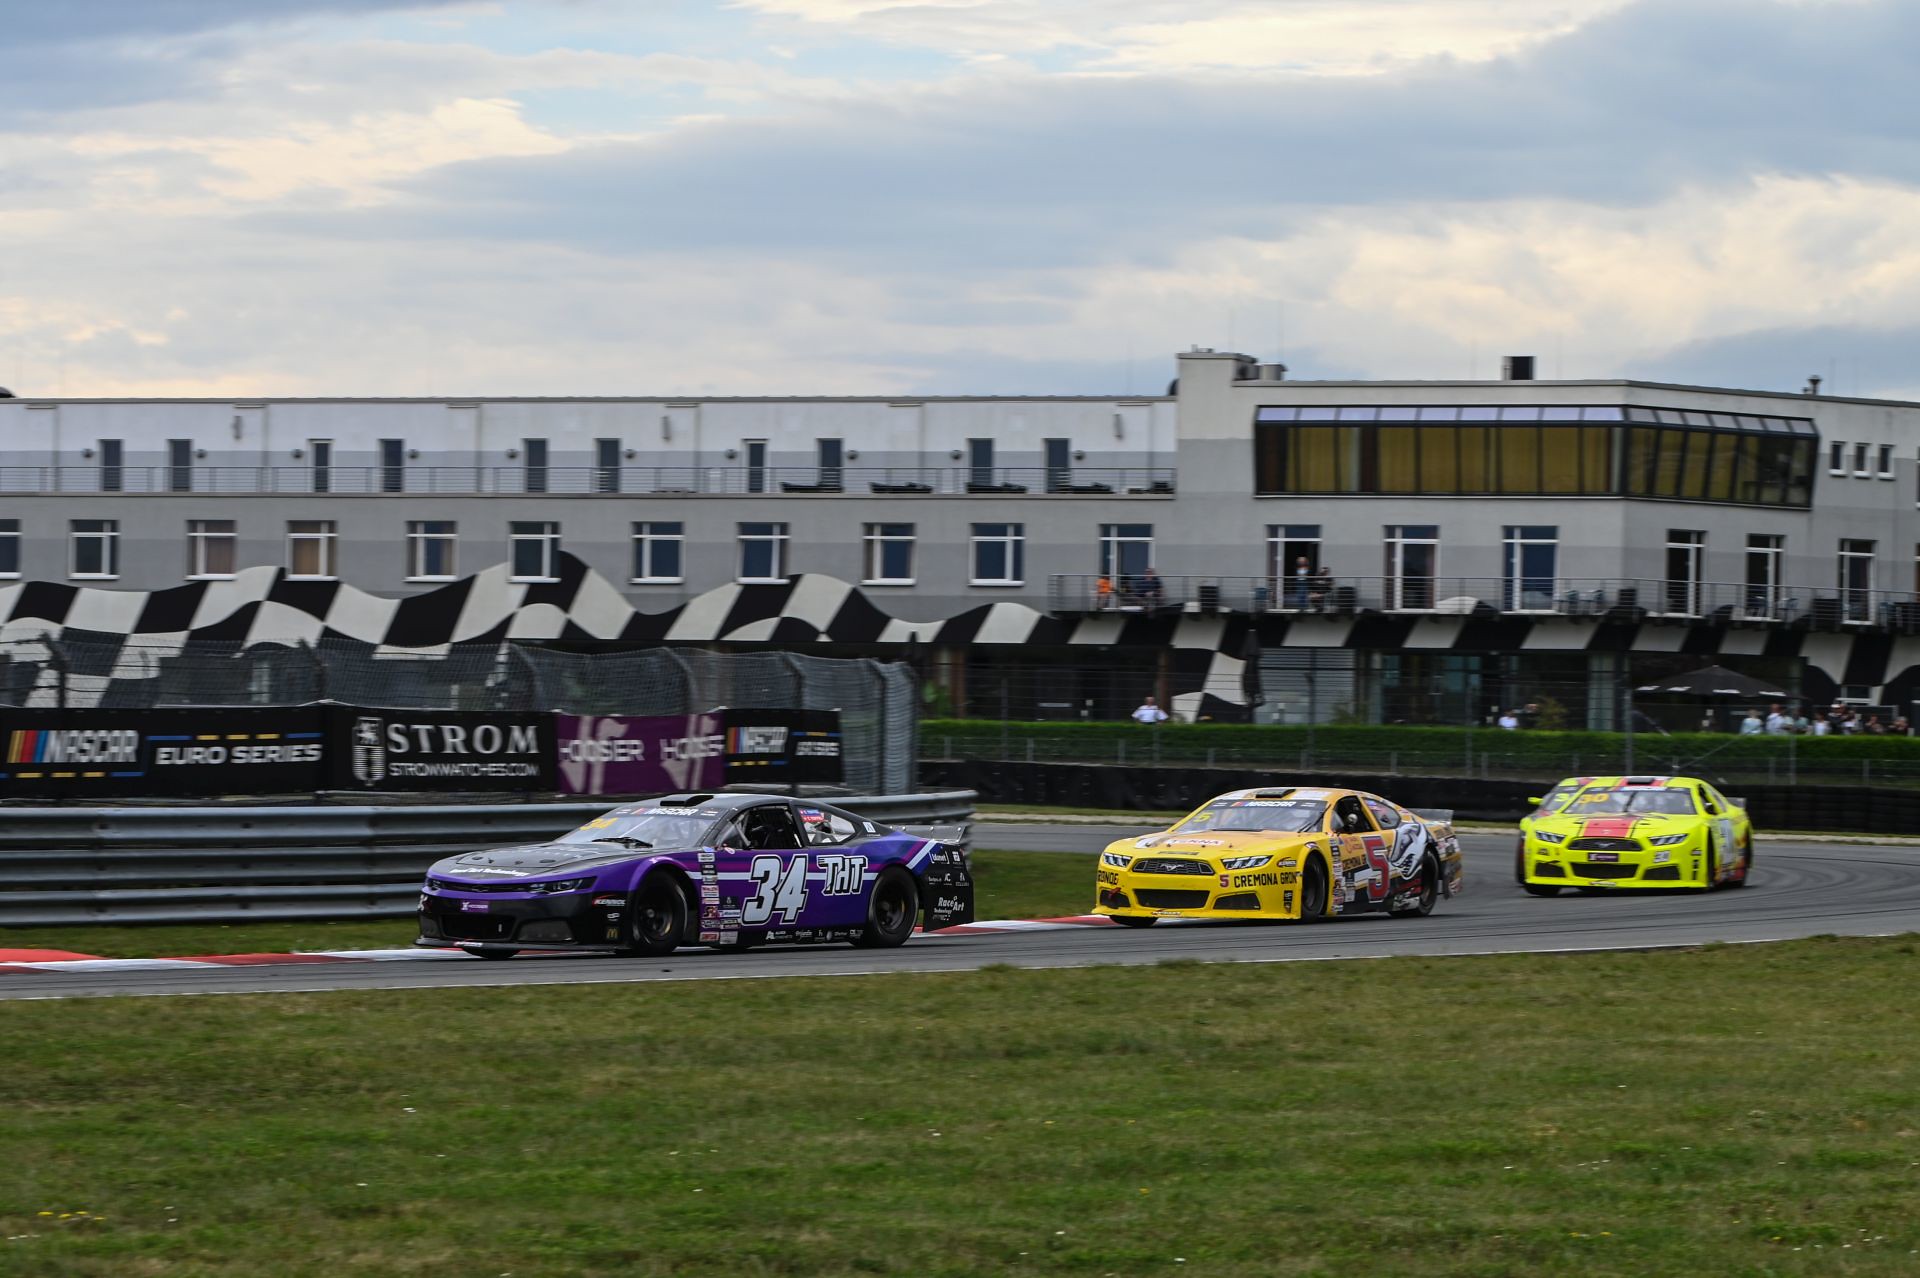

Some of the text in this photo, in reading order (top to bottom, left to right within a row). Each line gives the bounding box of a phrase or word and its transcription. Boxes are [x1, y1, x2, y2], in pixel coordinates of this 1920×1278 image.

[44, 730, 138, 763] NASCAR
[387, 723, 540, 754] STROM
[155, 744, 322, 765] EURO SERIES
[645, 807, 699, 816] NASCAR
[1219, 874, 1230, 888] 5
[1233, 872, 1279, 888] CREMONA
[1361, 834, 1391, 903] 5
[740, 853, 809, 926] 34
